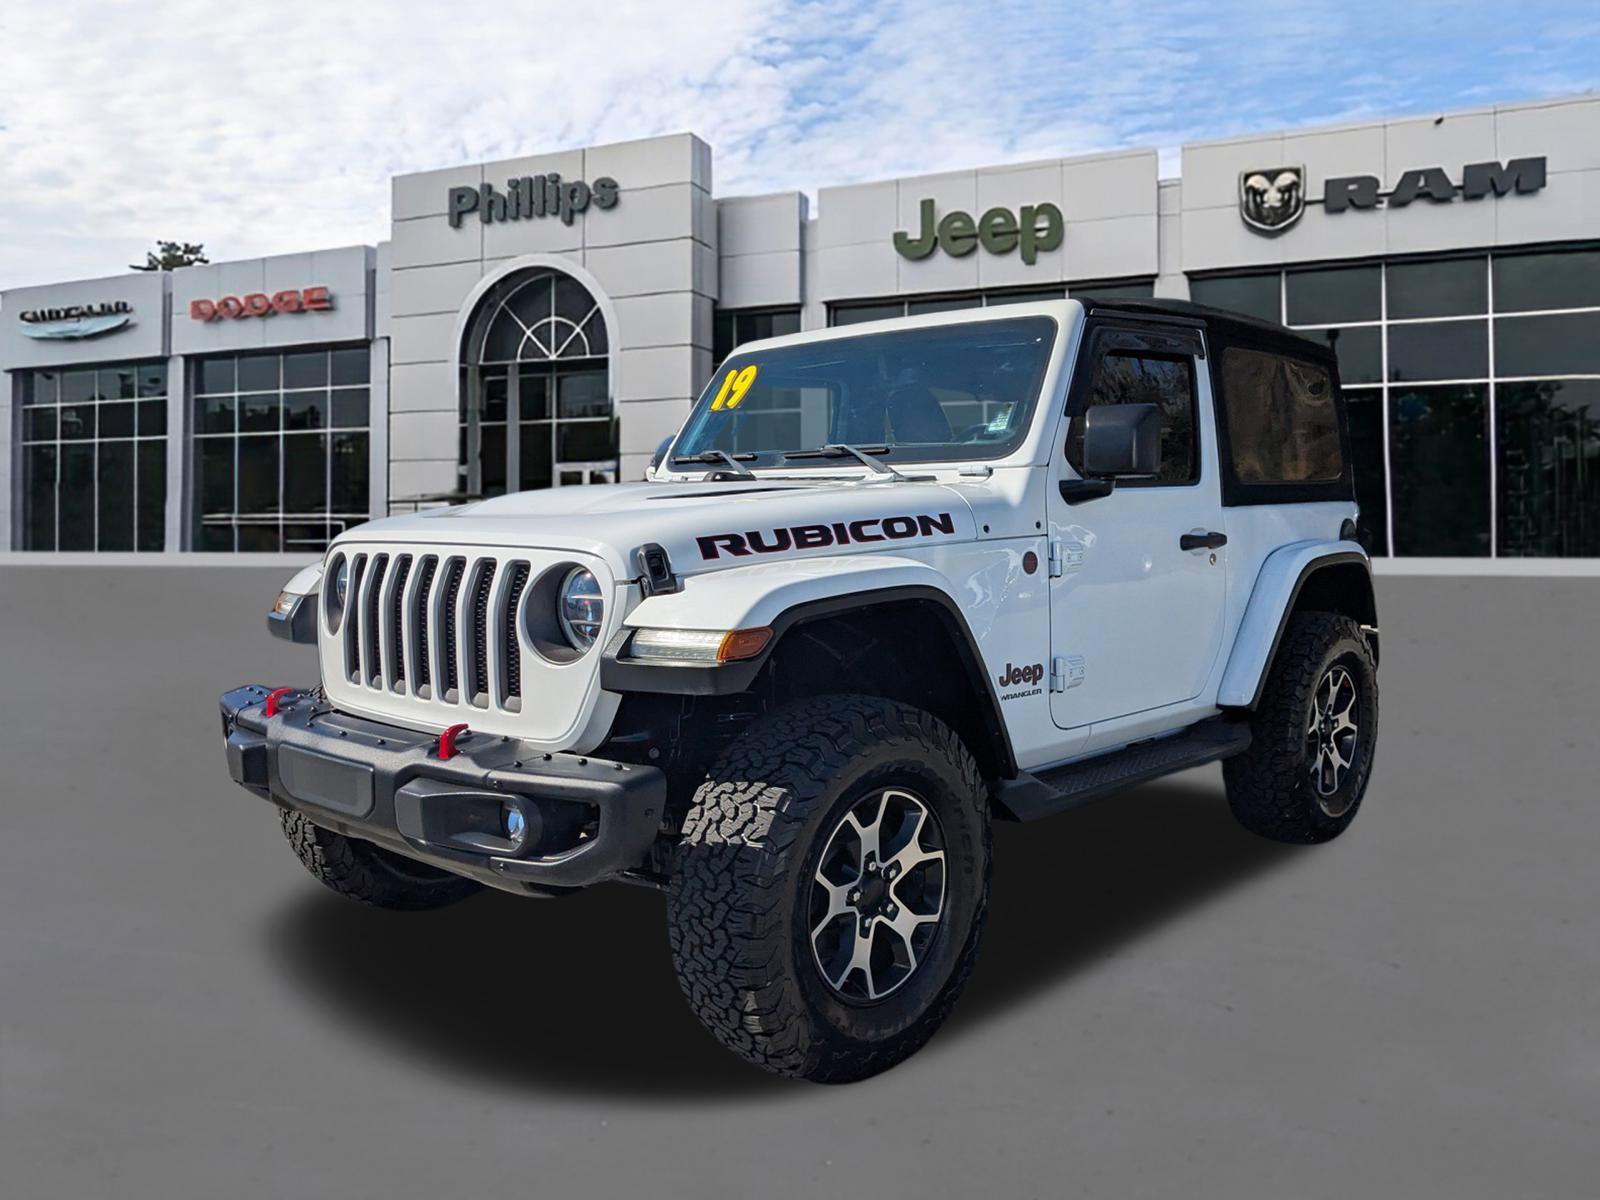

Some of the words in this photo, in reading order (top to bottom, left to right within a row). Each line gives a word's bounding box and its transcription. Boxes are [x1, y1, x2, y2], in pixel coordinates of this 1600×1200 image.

[448, 173, 620, 229] Phillips
[1325, 156, 1547, 214] RAM
[893, 198, 1065, 266] Jeep
[190, 286, 332, 322] DODGE
[709, 363, 759, 412] 19
[695, 512, 955, 560] RUBICON
[999, 663, 1044, 687] Jeep
[1000, 688, 1043, 701] WRANGLER
